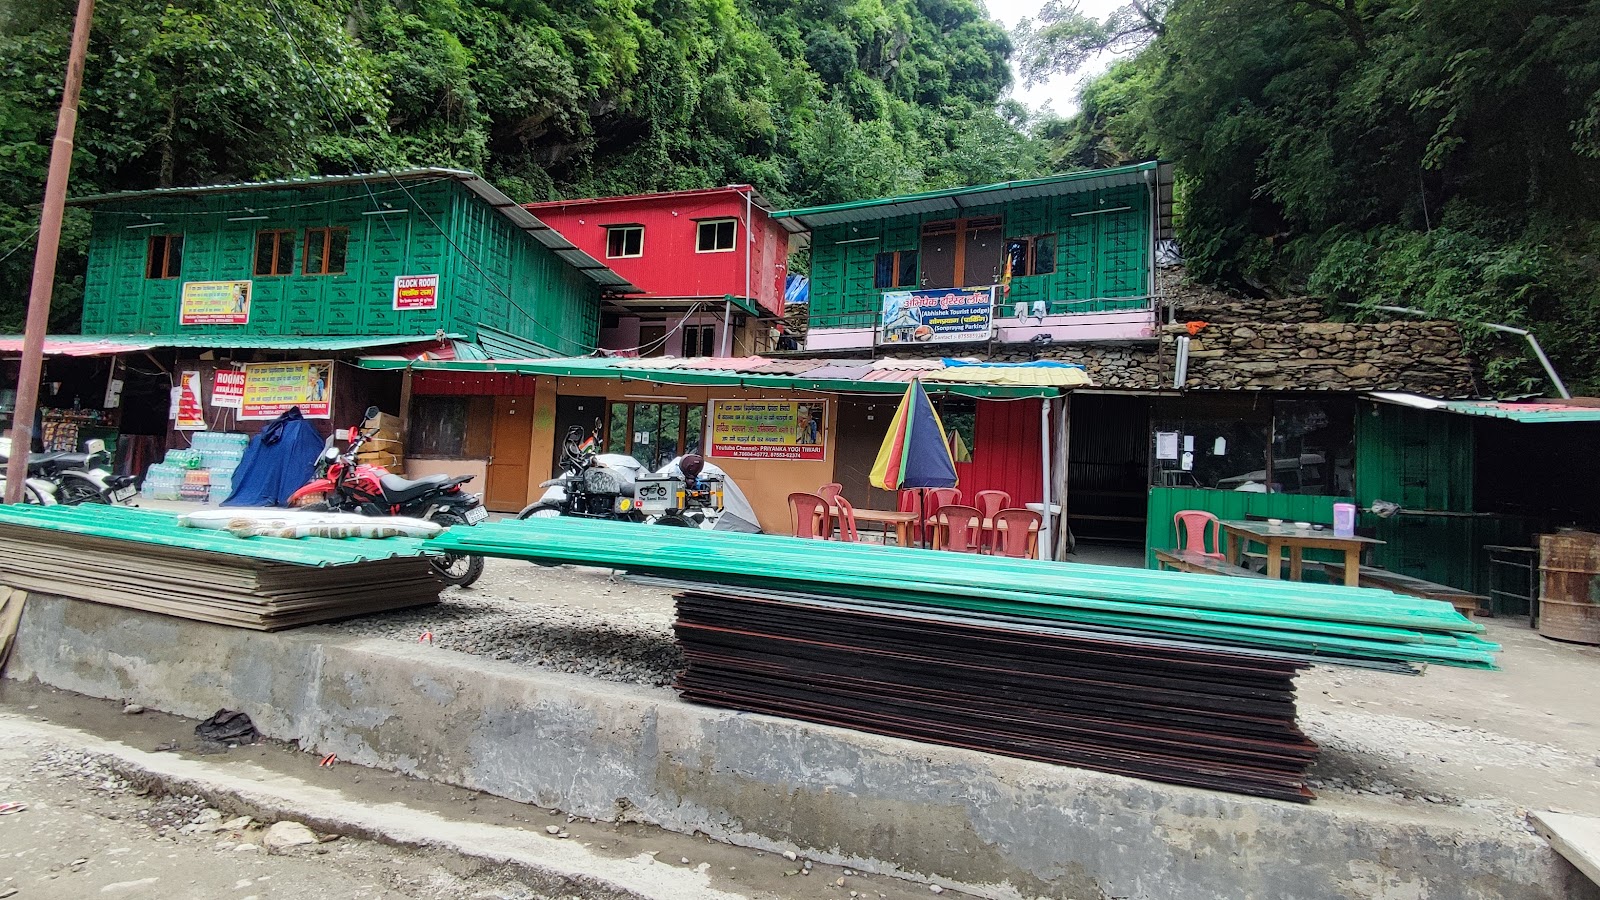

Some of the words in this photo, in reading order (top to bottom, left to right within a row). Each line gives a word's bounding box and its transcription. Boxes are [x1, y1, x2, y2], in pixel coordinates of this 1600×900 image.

[399, 279, 418, 288] CLOCK
[419, 278, 436, 287] ROOM
[922, 309, 950, 318] (Abhishek
[970, 307, 990, 315] Lodge)
[217, 373, 245, 384] ROOMS
[215, 385, 243, 394] AVAILABLE
